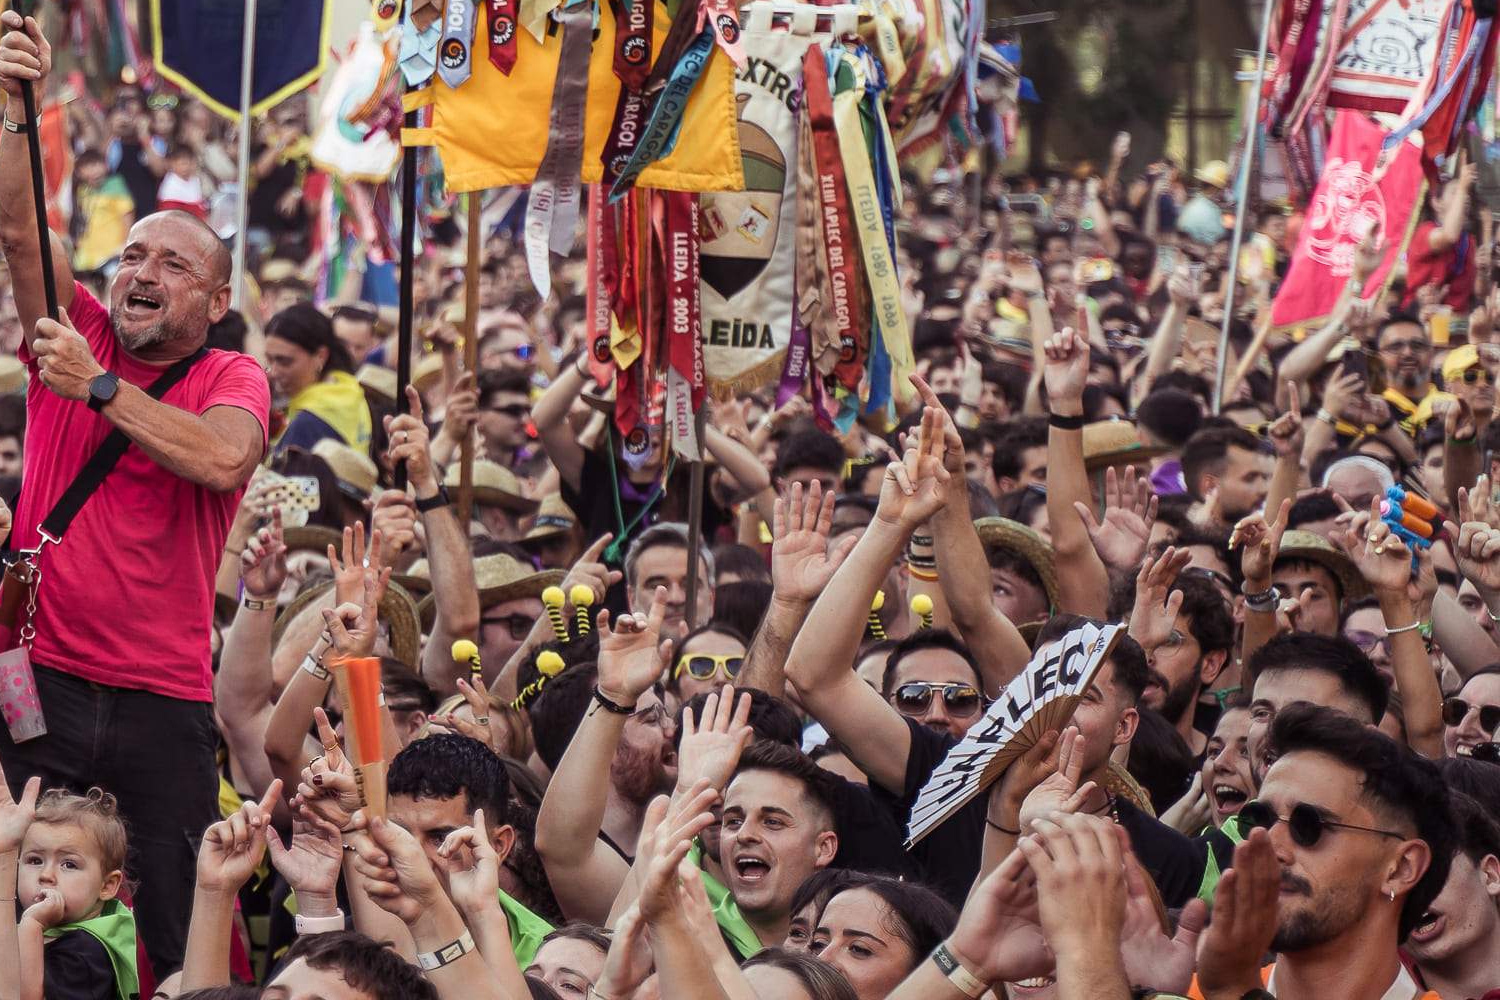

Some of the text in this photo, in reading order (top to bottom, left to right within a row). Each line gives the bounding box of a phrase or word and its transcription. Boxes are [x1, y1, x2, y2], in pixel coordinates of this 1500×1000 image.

[823, 205, 842, 243] APLEC
[674, 232, 688, 283] LLEIDA
[828, 243, 844, 267] DEL
[674, 298, 689, 334] 2003
[831, 267, 852, 331] CARAGOL
